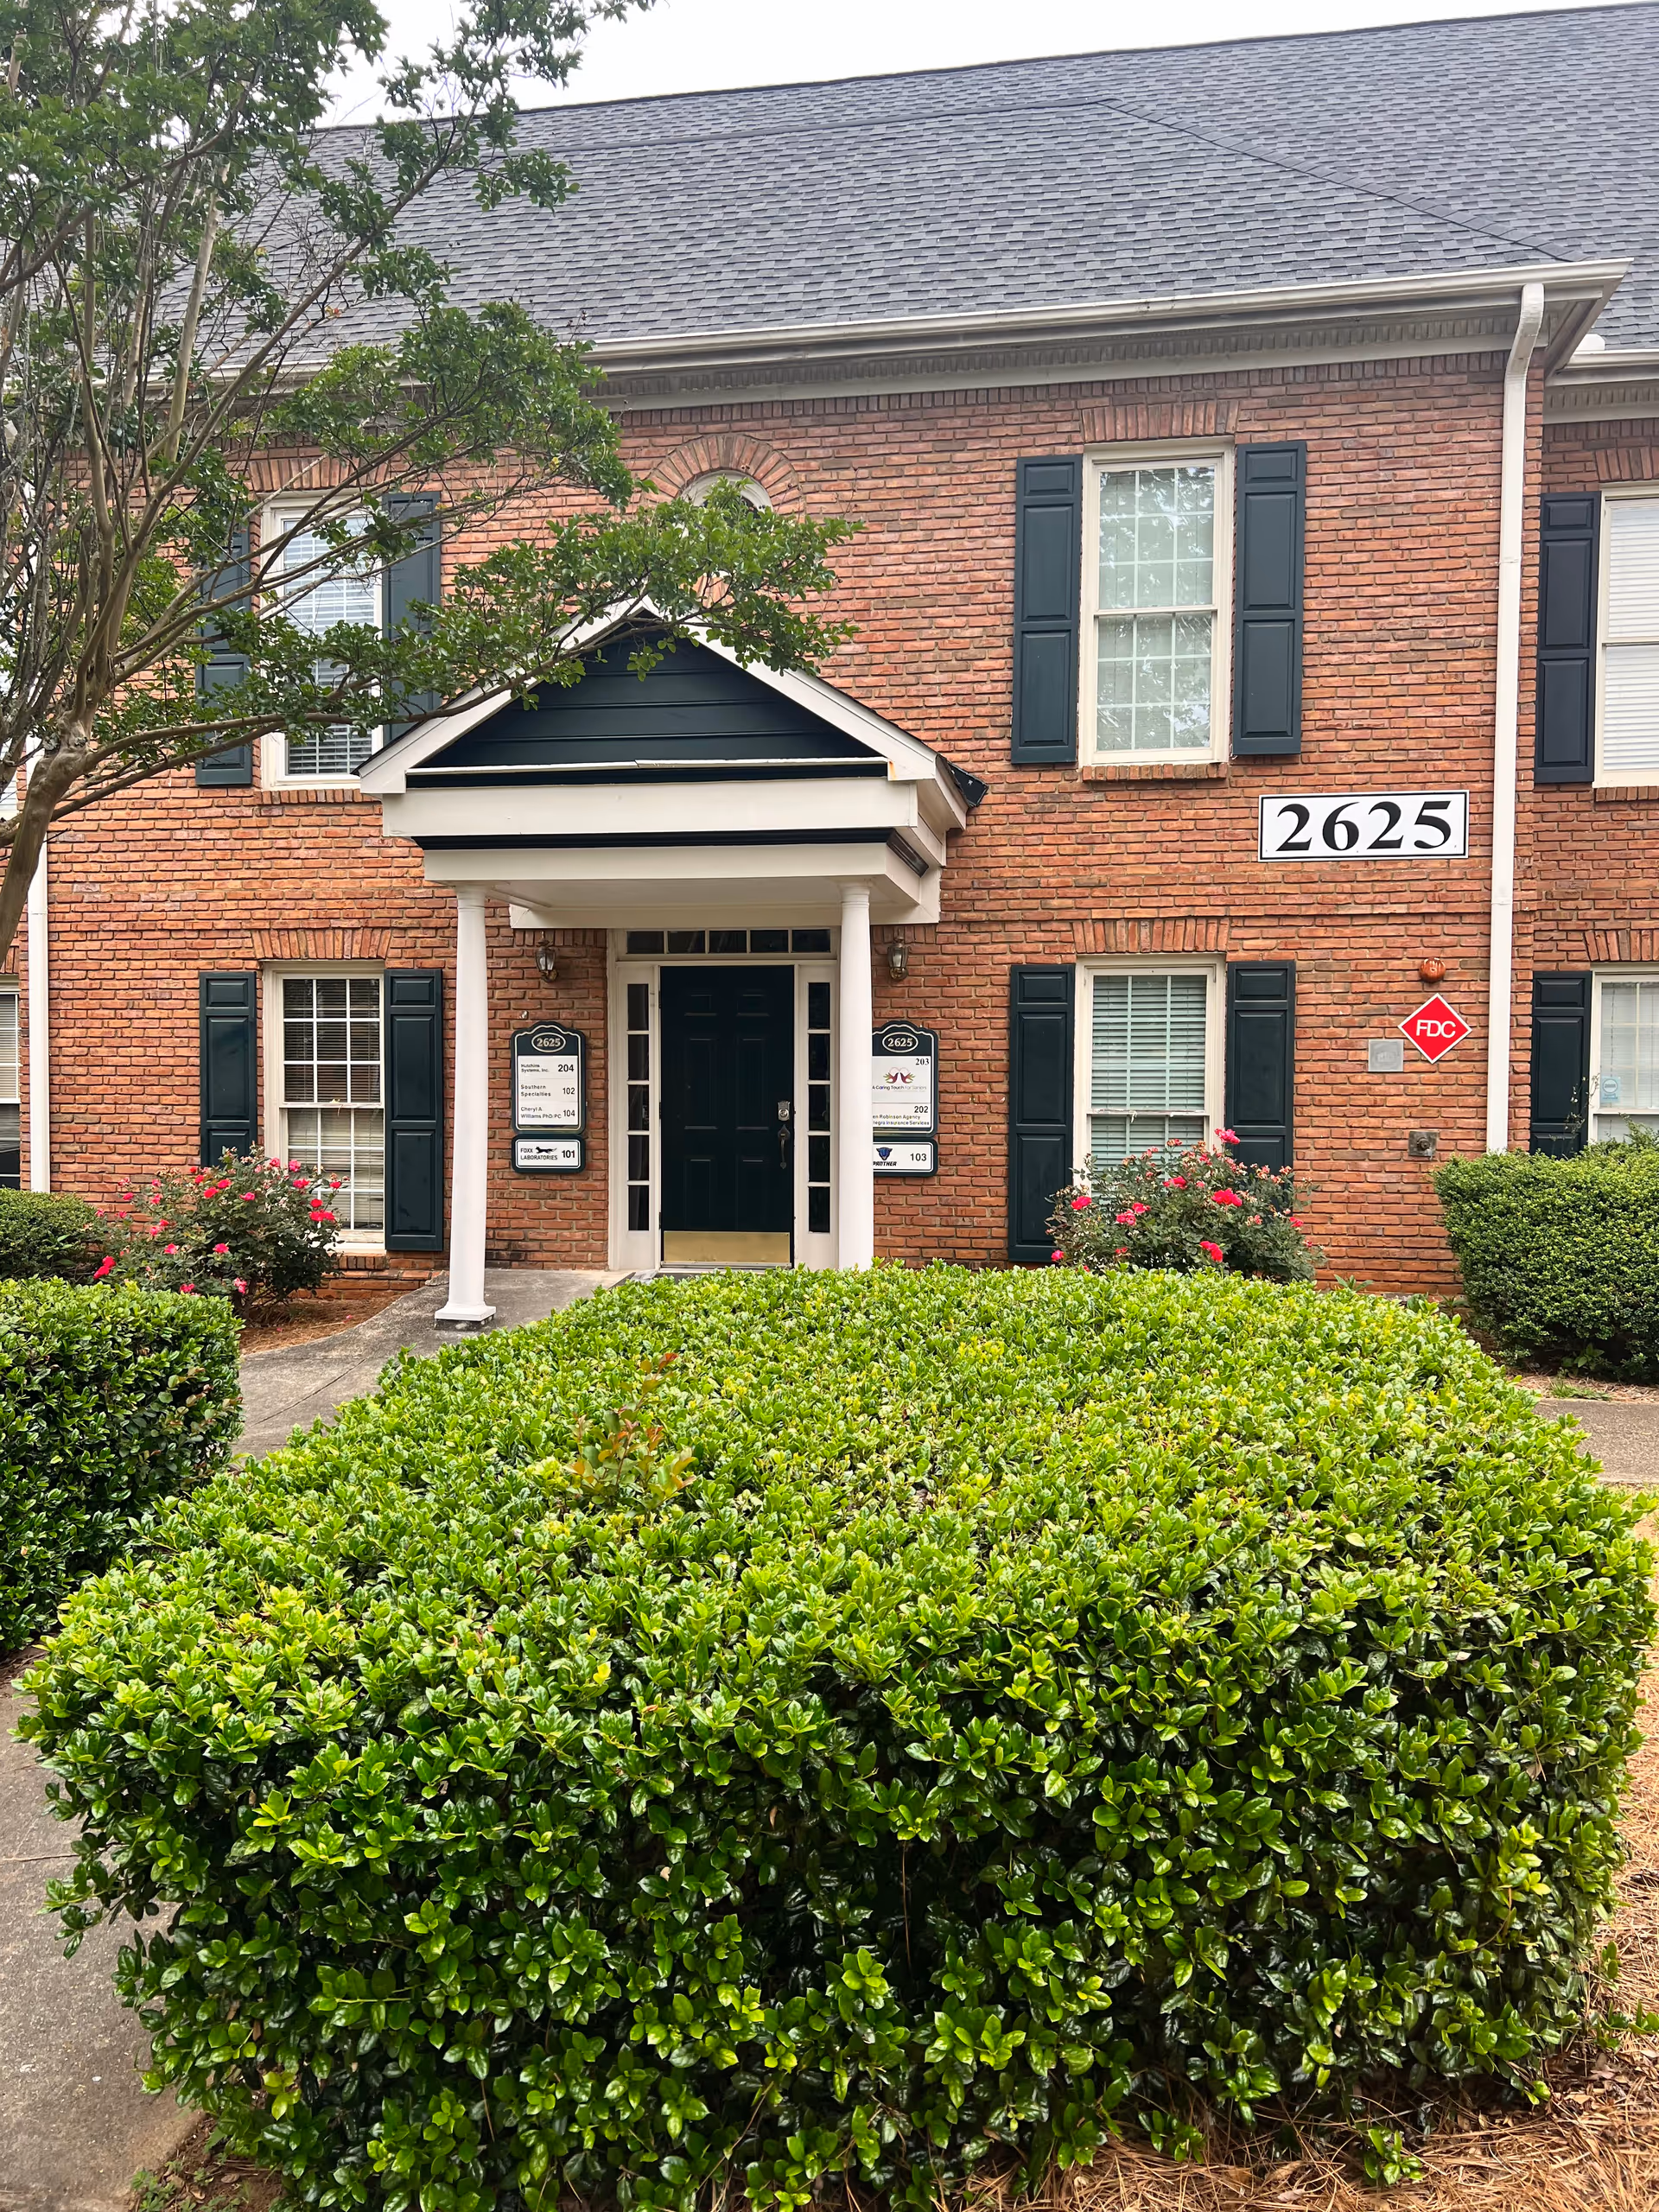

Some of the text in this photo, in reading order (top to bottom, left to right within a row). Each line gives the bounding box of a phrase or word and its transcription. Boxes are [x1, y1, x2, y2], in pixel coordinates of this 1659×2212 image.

[1275, 800, 1452, 852] 2625
[1415, 1019, 1456, 1039] FDC
[537, 1038, 562, 1047] 2625
[887, 1038, 913, 1047] 2625
[557, 1064, 575, 1072] 204
[561, 1149, 575, 1158] 101
[910, 1153, 927, 1161] 103
